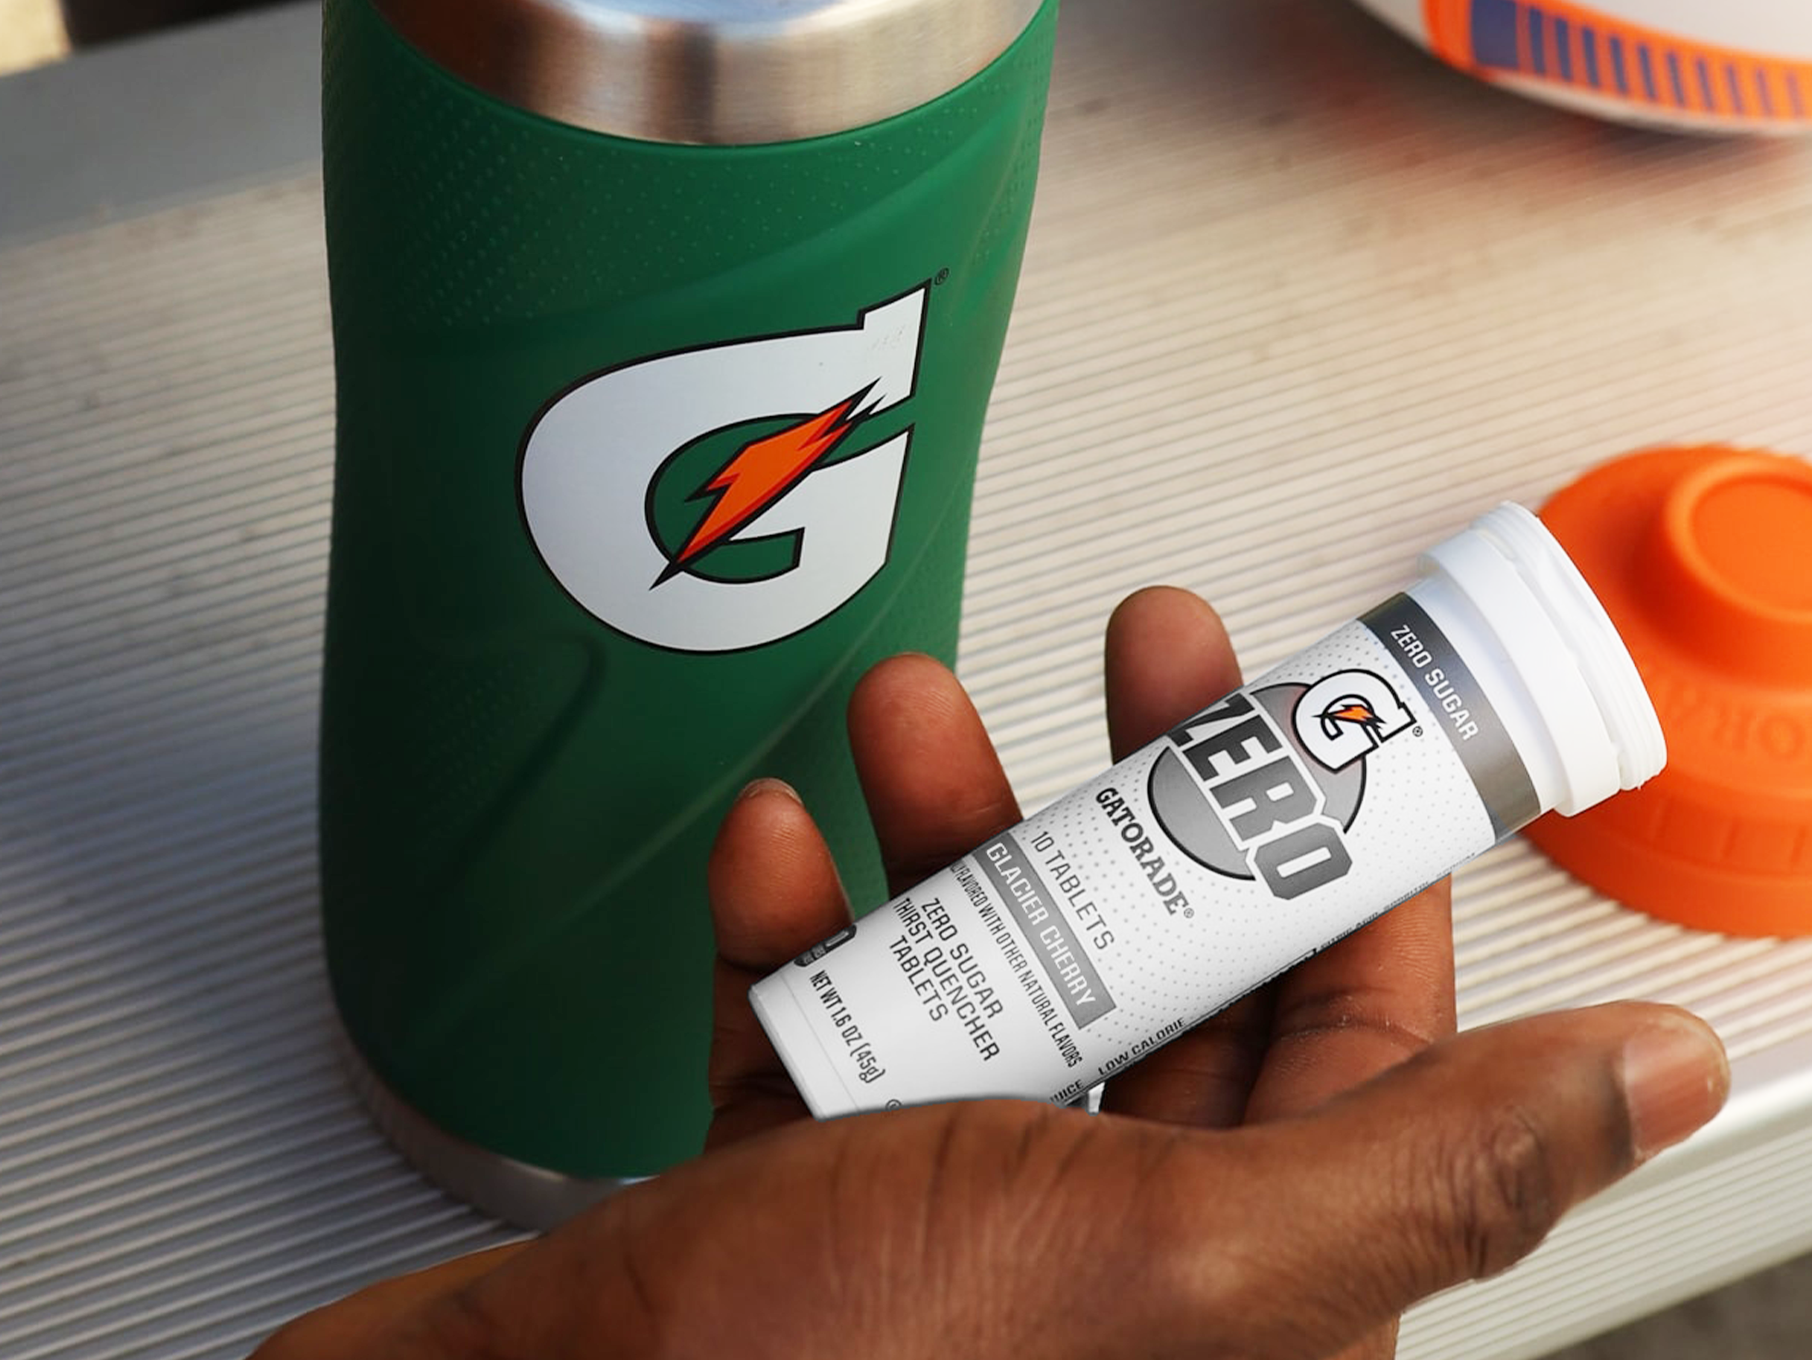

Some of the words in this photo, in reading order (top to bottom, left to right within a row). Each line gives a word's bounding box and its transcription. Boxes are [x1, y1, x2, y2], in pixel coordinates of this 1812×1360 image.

[1391, 624, 1433, 668] ZERO
[1424, 668, 1479, 741] SUGAR
[1165, 691, 1354, 901] ZERO
[985, 842, 1049, 926] GLACIER
[1039, 925, 1097, 1006] CHERRY
[1030, 830, 1055, 853] 10
[1045, 849, 1115, 950] TABLETS
[809, 969, 832, 992] NET
[819, 986, 844, 1010] WT
[889, 935, 949, 1022] TABLETS
[893, 897, 934, 945] THIRST
[923, 946, 1001, 1062] QUENCHER
[921, 897, 959, 942] ZERO
[949, 942, 1004, 1019] SUGAR
[978, 902, 1007, 937] WITH
[996, 931, 1028, 974] OTHER
[1018, 968, 1056, 1027] NATURAL
[1049, 1021, 1083, 1068] FLAVORS
[830, 1006, 852, 1028] 1.6
[841, 1025, 864, 1047] OZ
[849, 1042, 887, 1084] (45g)
[1098, 1051, 1130, 1076] LOW
[1130, 1017, 1187, 1055] CALORIE
